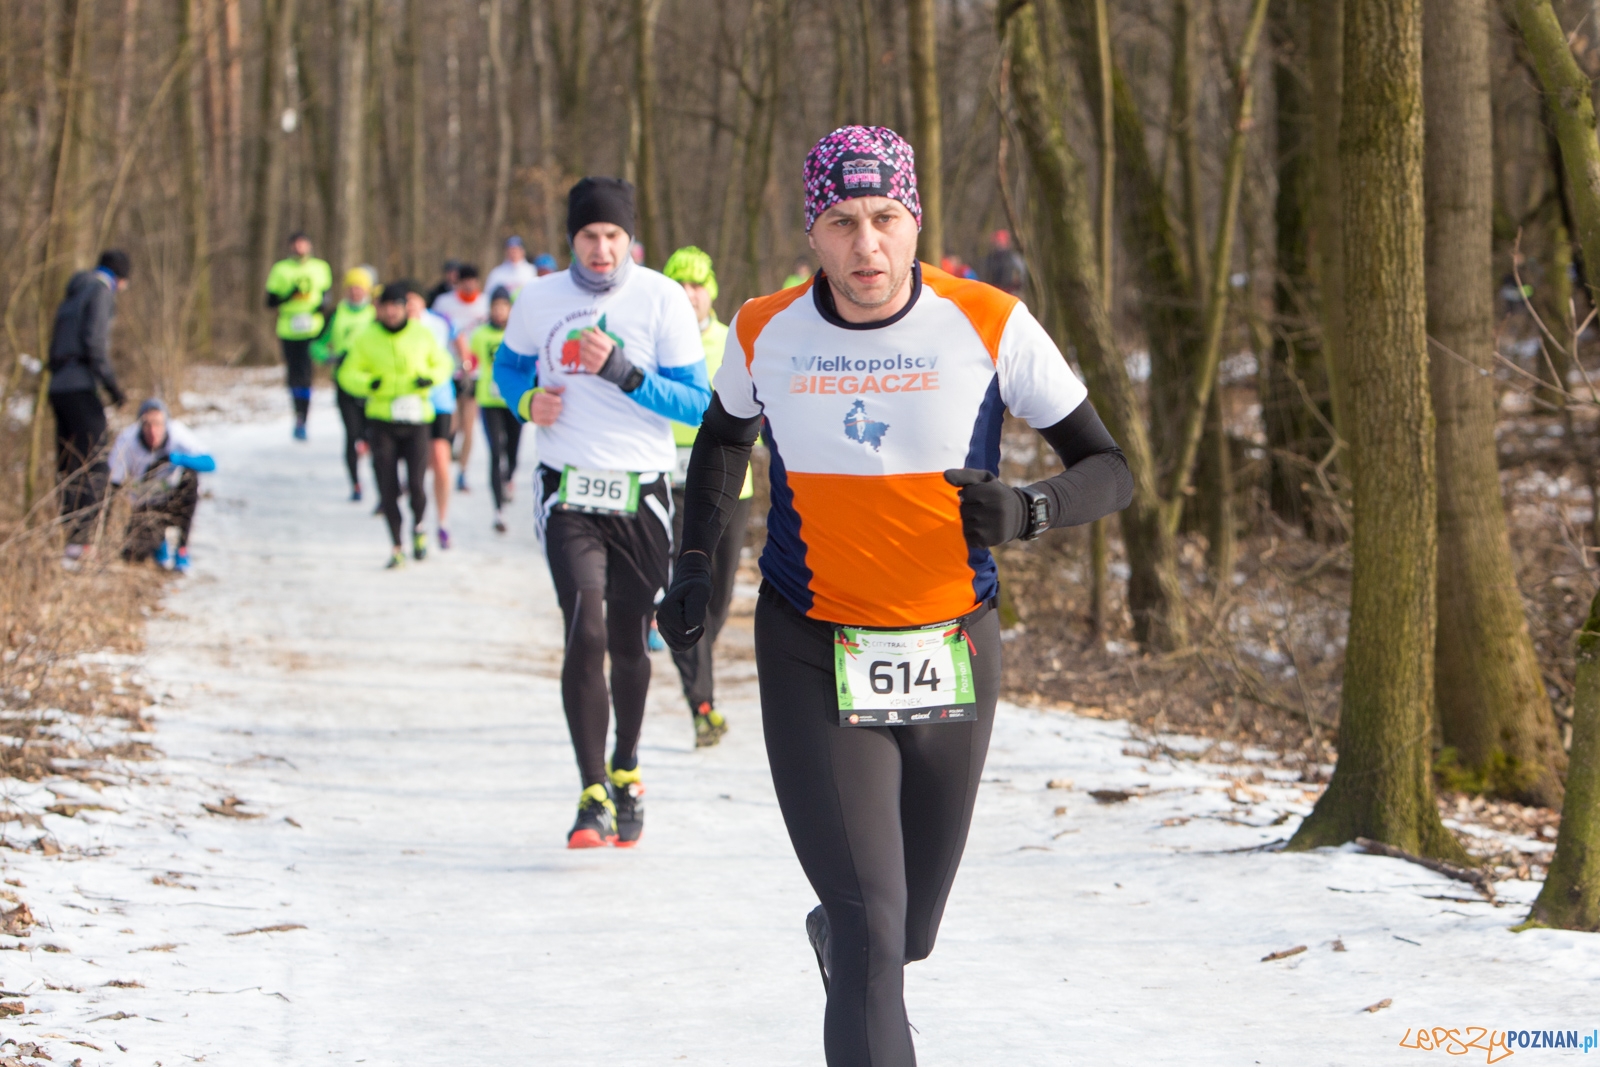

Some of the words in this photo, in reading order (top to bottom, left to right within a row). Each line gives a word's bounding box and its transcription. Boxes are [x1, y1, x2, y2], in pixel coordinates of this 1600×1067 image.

[791, 353, 938, 373] Wielkopolscy
[789, 371, 940, 395] BIEGACZE
[576, 476, 622, 499] 396
[869, 659, 941, 694] 614
